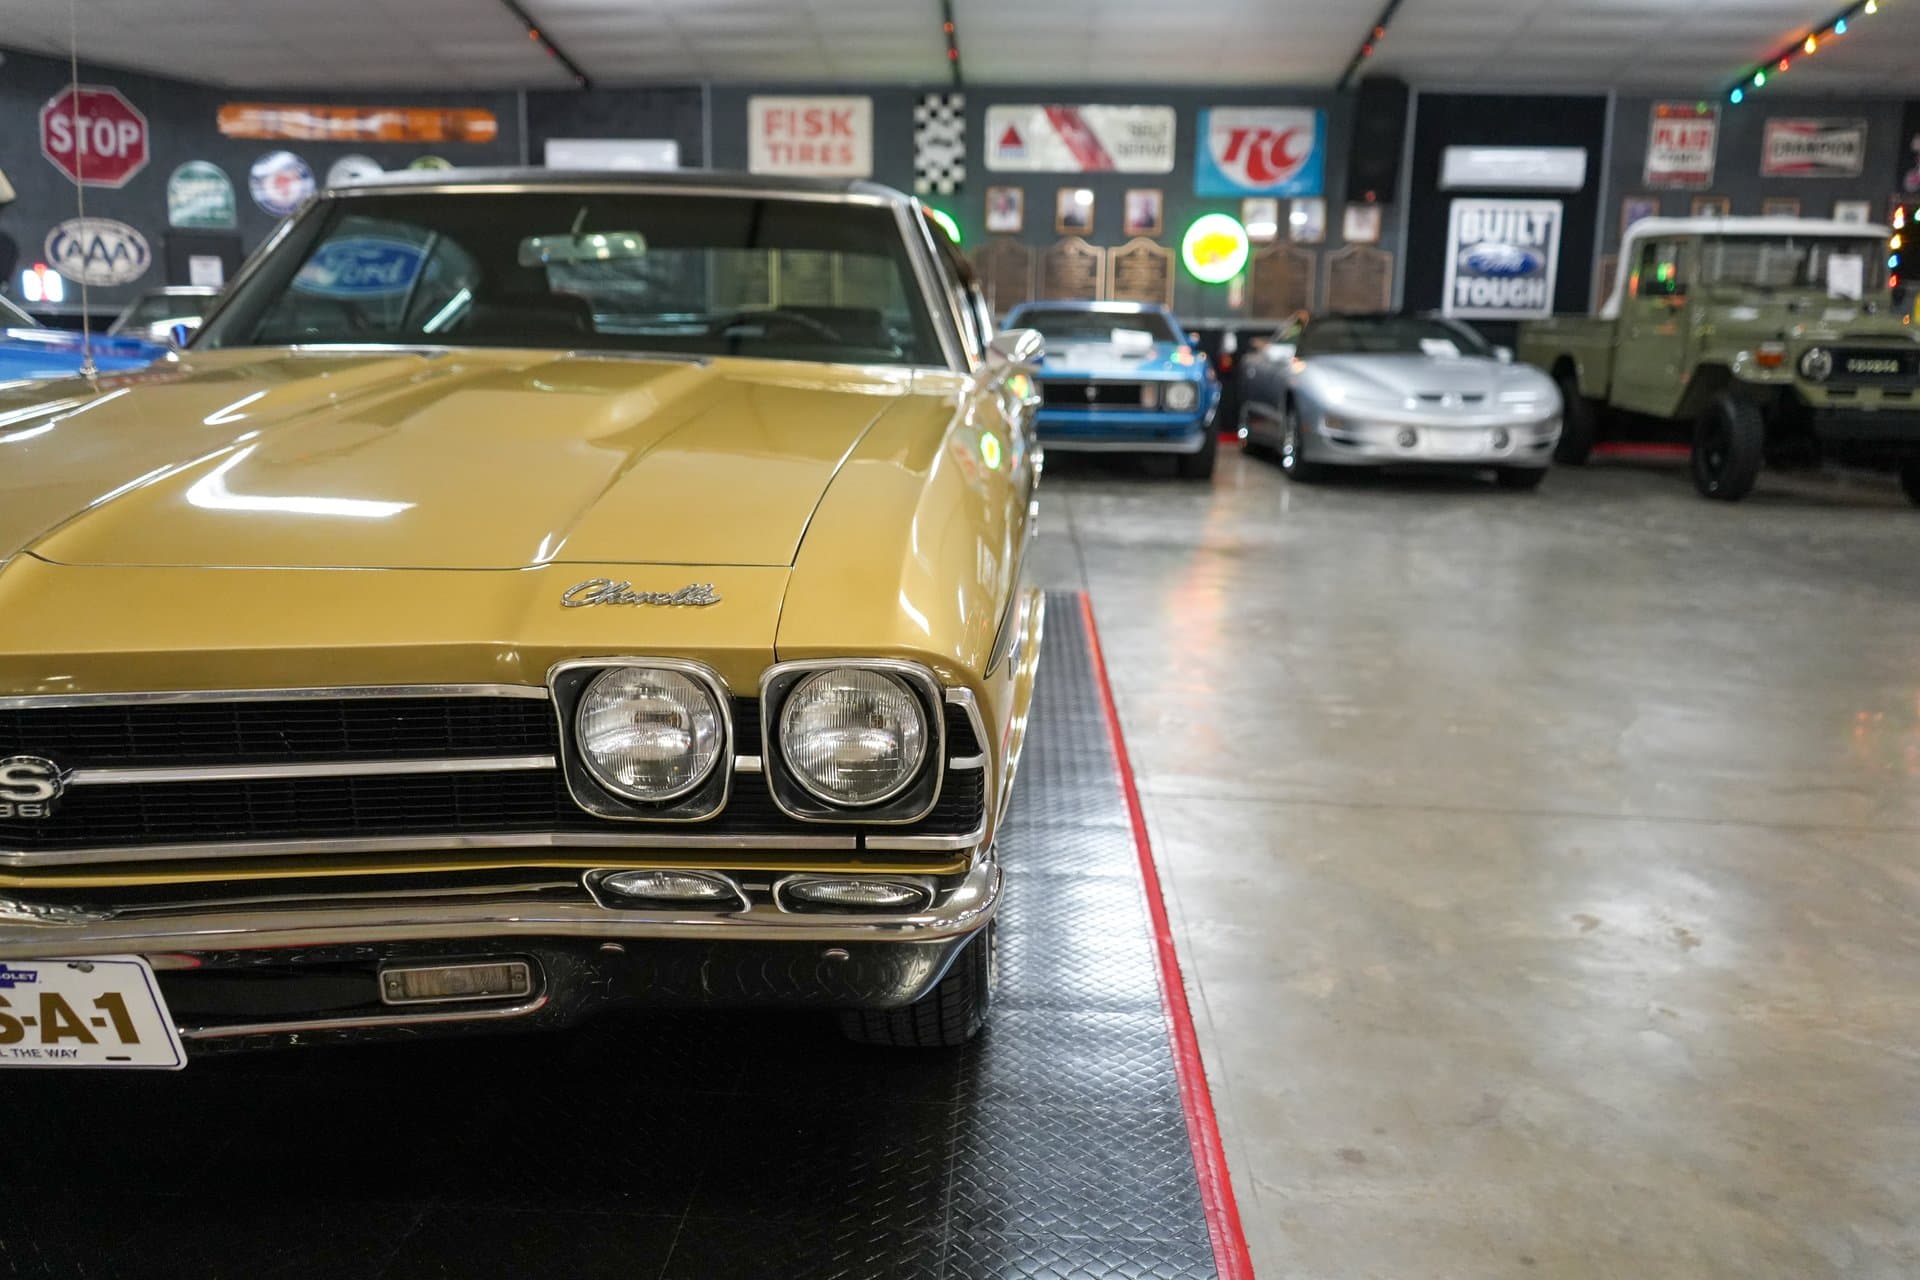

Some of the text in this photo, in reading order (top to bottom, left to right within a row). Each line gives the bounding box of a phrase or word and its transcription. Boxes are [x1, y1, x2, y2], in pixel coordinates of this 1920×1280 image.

[50, 114, 140, 158] STOP
[763, 108, 854, 139] FISK
[767, 143, 855, 166] TIRES
[1460, 209, 1549, 246] BUILT
[66, 234, 130, 268] AAA
[1456, 277, 1546, 308] TOUGH
[1847, 359, 1898, 373] TOYOTA
[561, 578, 721, 607] Chevelle
[10, 1048, 41, 1058] THE
[45, 1048, 78, 1058] WAY
